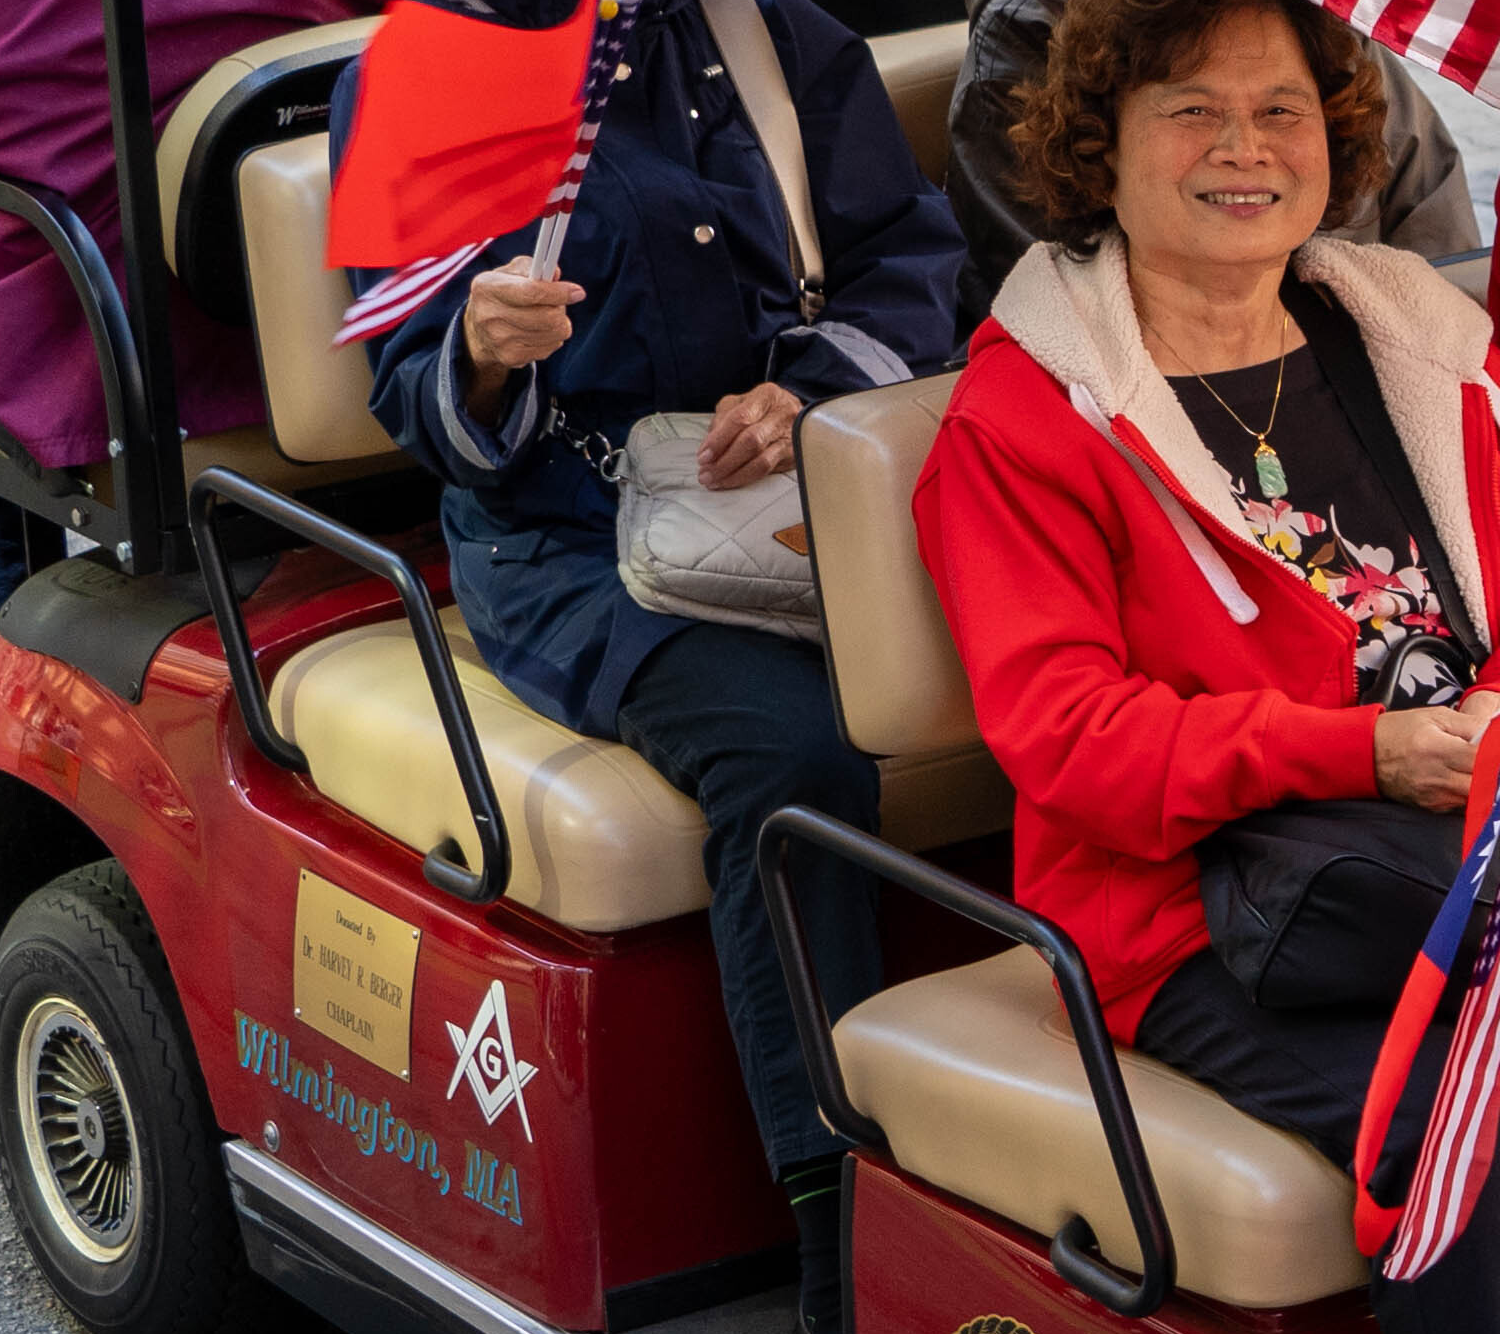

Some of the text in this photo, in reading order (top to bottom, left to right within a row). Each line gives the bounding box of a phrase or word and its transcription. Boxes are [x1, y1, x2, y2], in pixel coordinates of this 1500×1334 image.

[335, 909, 376, 946] Donated By
[303, 935, 314, 961] Dr.
[319, 944, 353, 982] HARVEY
[370, 972, 403, 1011] BERGER
[326, 1000, 375, 1042] CHAPLAIN
[478, 1036, 503, 1081] G
[234, 1008, 524, 1227] Wilmington, MA
